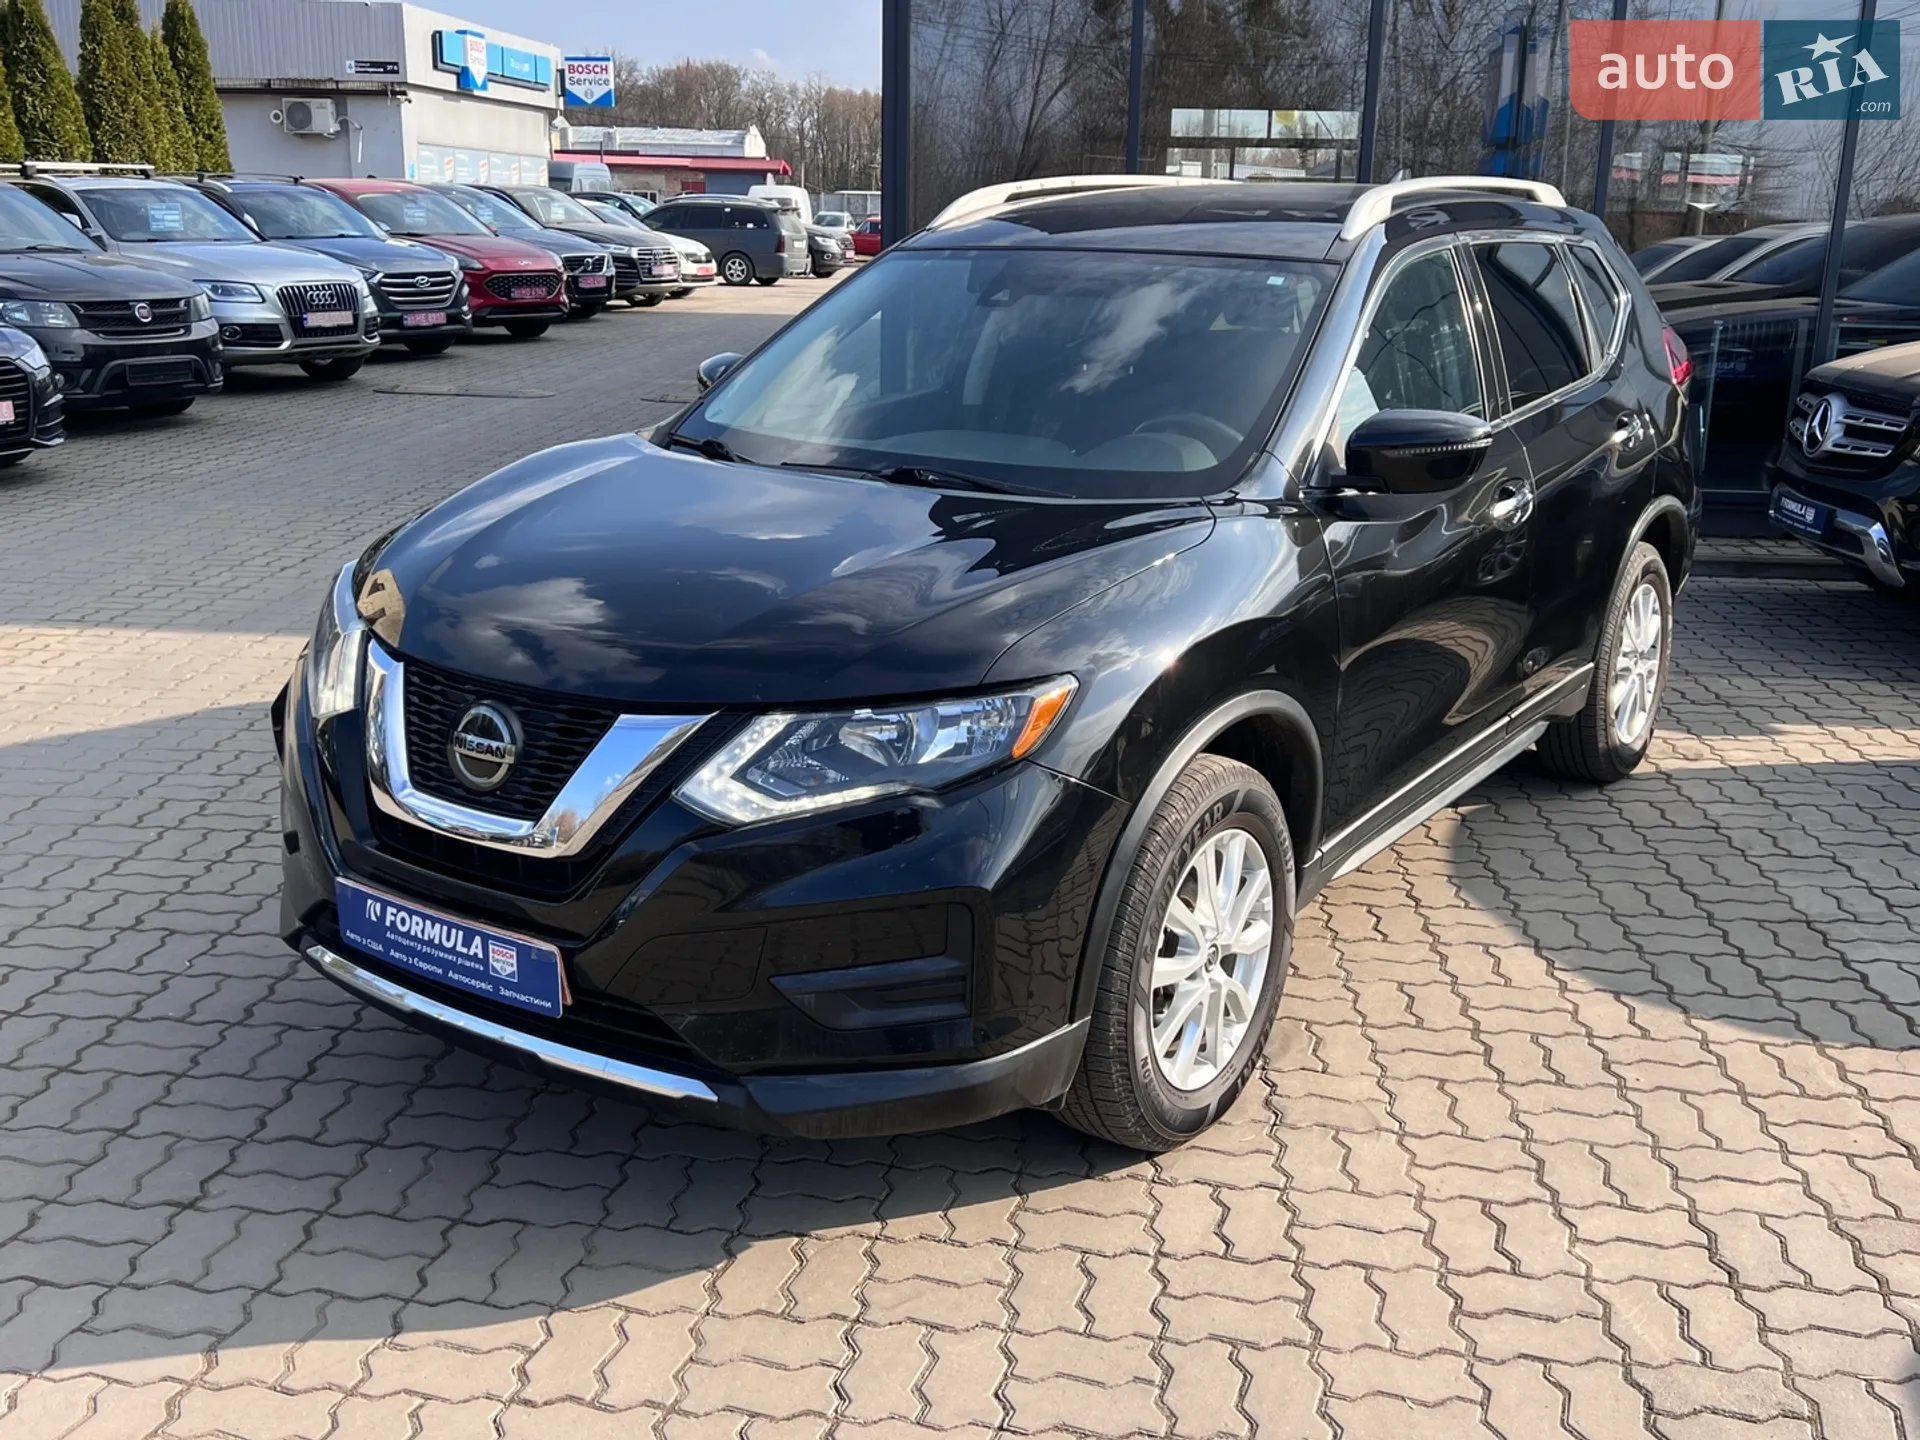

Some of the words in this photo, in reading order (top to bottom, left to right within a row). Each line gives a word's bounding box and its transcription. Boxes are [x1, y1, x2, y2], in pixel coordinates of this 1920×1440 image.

[469, 39, 485, 53] BOSCH
[568, 64, 608, 75] BOSCH
[568, 76, 610, 86] Service
[454, 735, 507, 759] NISSAN
[385, 905, 483, 959] FORMULA
[386, 931, 422, 951] Автоцентр
[422, 944, 457, 962] розумних
[457, 957, 484, 971] рішень
[491, 946, 515, 960] BOSCH
[491, 955, 515, 968] Service
[346, 929, 361, 943] Авто
[366, 938, 384, 952] США
[389, 948, 407, 962] Авто
[413, 956, 443, 975] Європи
[447, 970, 494, 992] Автосервіс
[498, 985, 552, 1009] Запчастини
